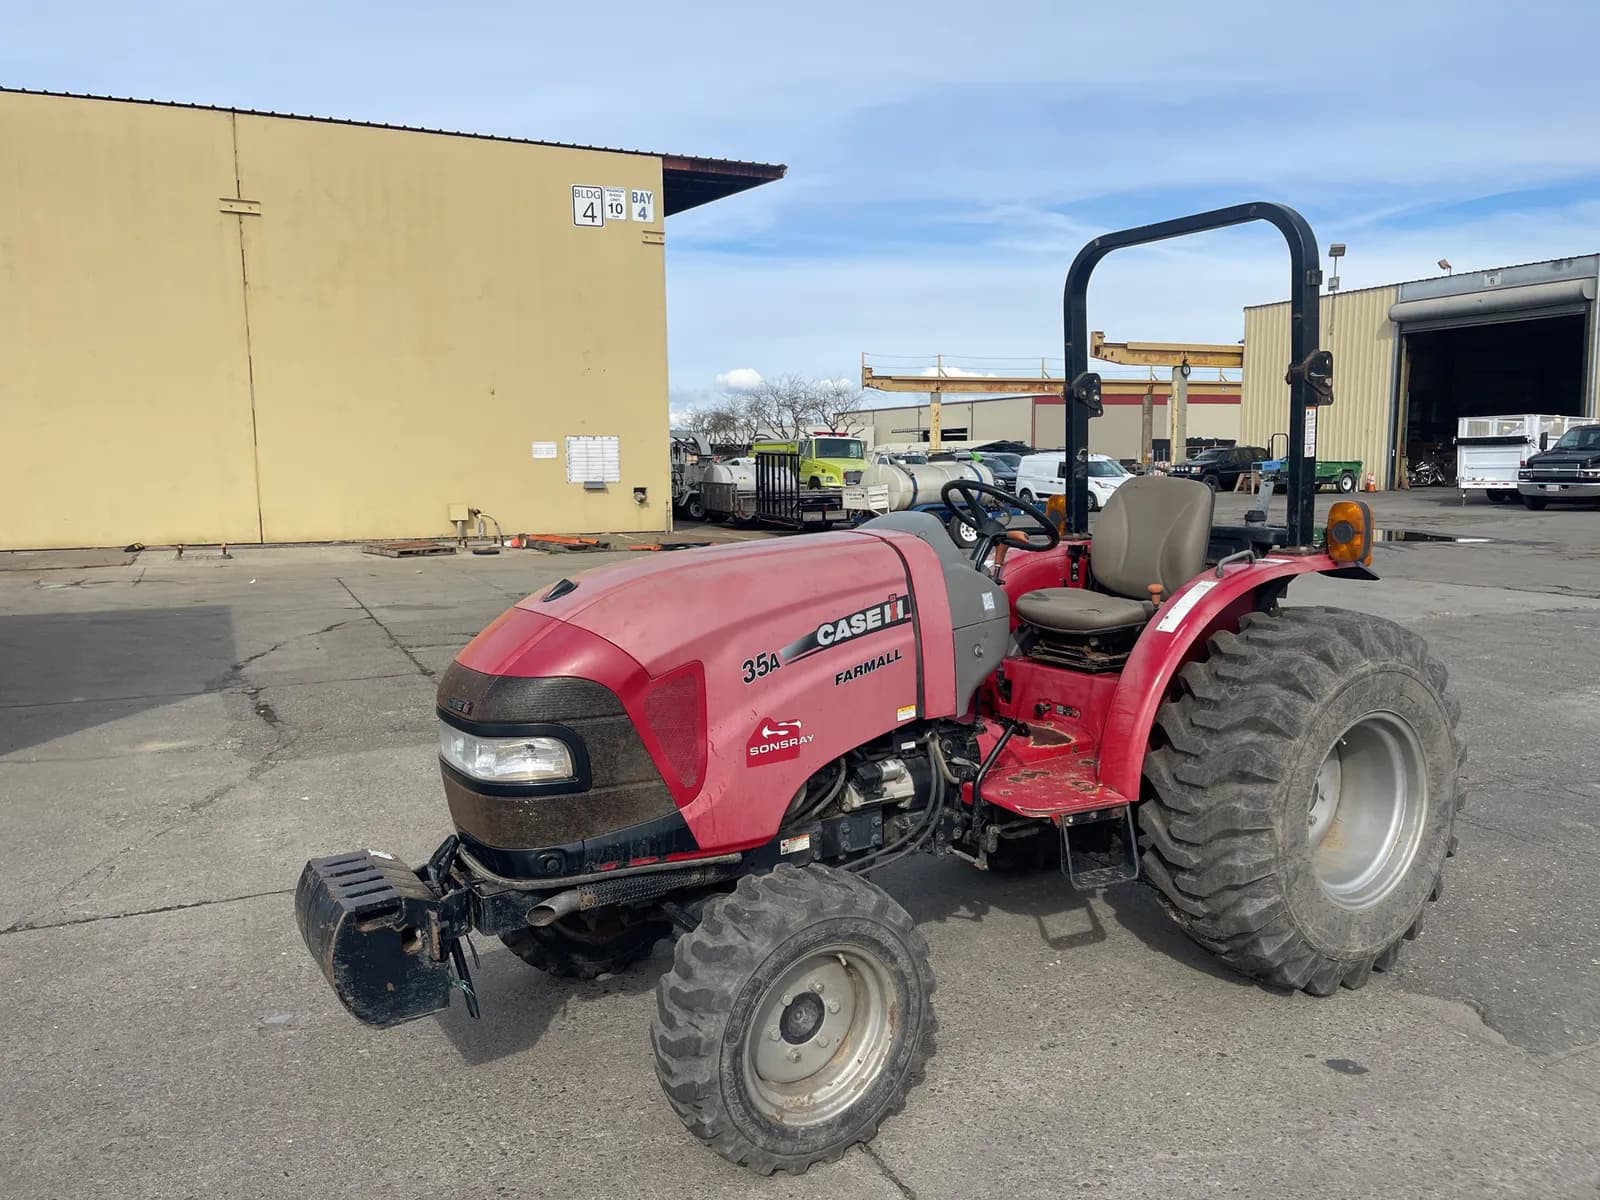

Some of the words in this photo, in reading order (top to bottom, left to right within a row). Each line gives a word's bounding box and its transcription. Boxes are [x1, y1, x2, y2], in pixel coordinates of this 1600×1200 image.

[574, 189, 601, 200] BLDG
[631, 191, 652, 205] BAY
[582, 202, 598, 223] 4
[607, 203, 623, 215] 10
[637, 206, 648, 220] 4
[816, 609, 882, 647] CASE
[741, 651, 781, 684] 35A
[834, 649, 902, 686] FARMALL
[749, 733, 815, 757] SONSRAY
